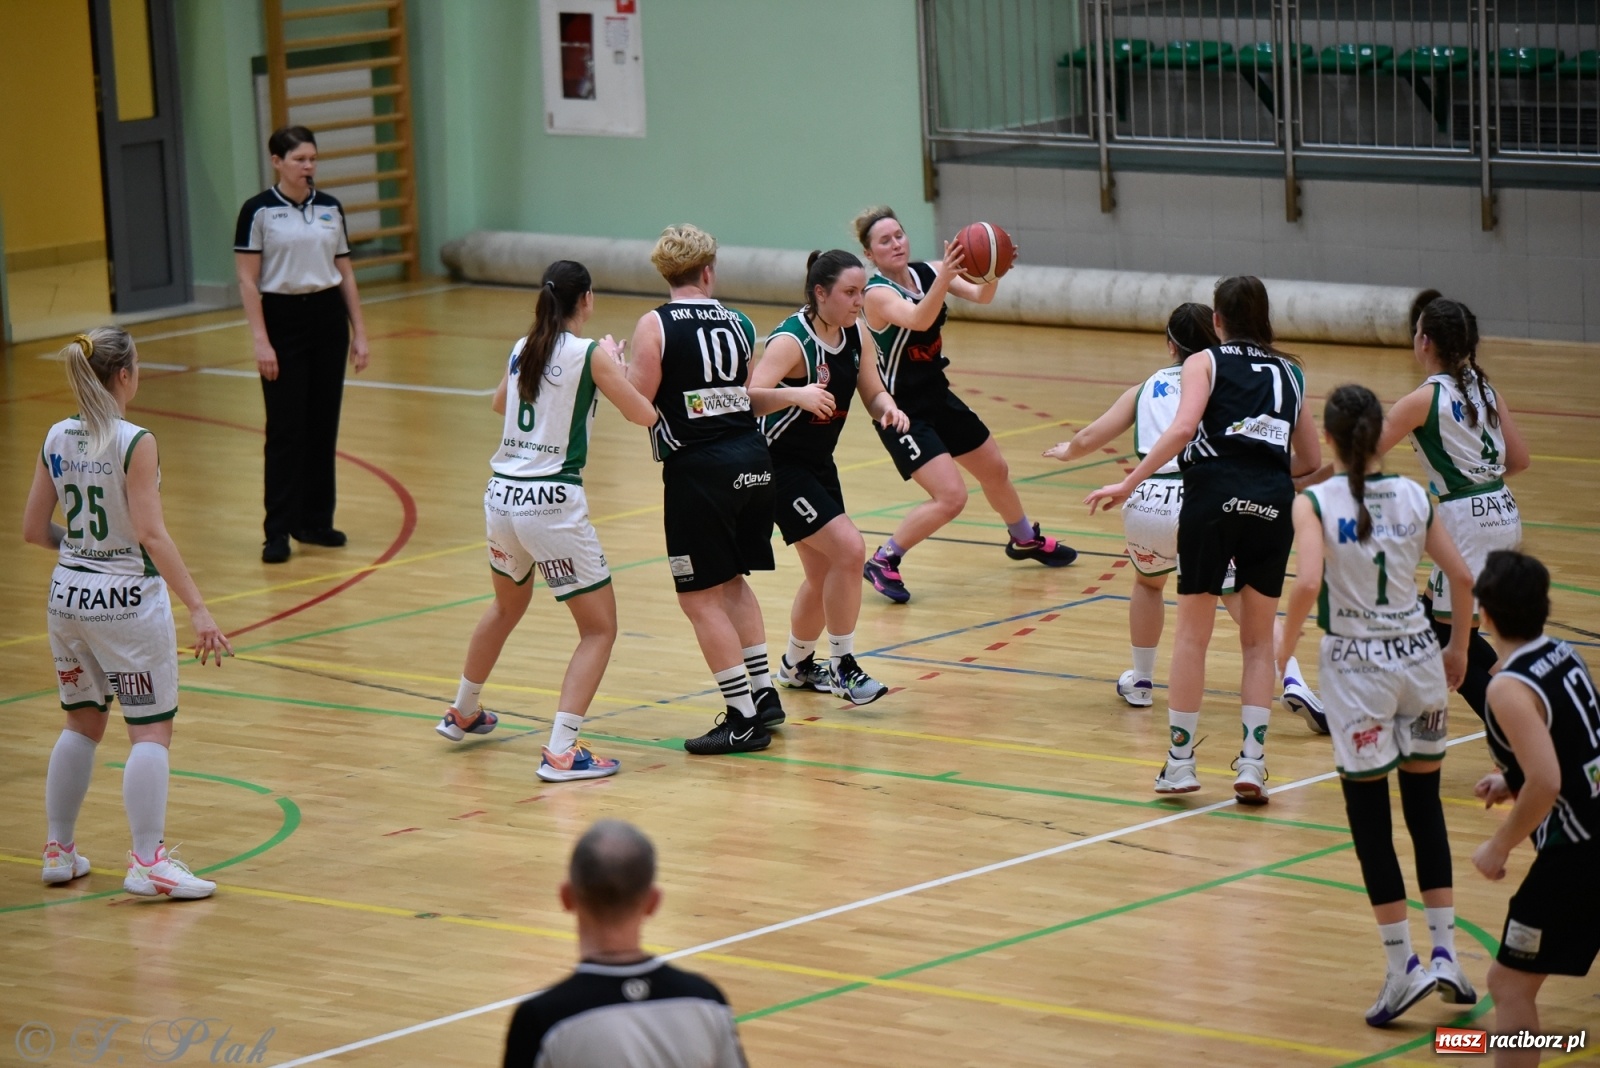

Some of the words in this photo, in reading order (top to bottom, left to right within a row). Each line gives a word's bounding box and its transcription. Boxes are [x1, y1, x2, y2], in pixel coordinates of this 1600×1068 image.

[670, 309, 693, 321] RKK
[697, 327, 739, 382] 10
[1219, 345, 1243, 356] RKK
[1251, 363, 1282, 413] 7
[518, 399, 535, 432] 6
[519, 440, 560, 454] KATOWICE
[899, 434, 921, 460] 3
[1481, 424, 1499, 465] 4
[64, 484, 109, 541] 25
[793, 497, 818, 523] 9
[1236, 499, 1280, 519] Clavis
[80, 547, 133, 558] KATOWICE
[1373, 551, 1388, 605] 1
[1435, 571, 1443, 597] 4
